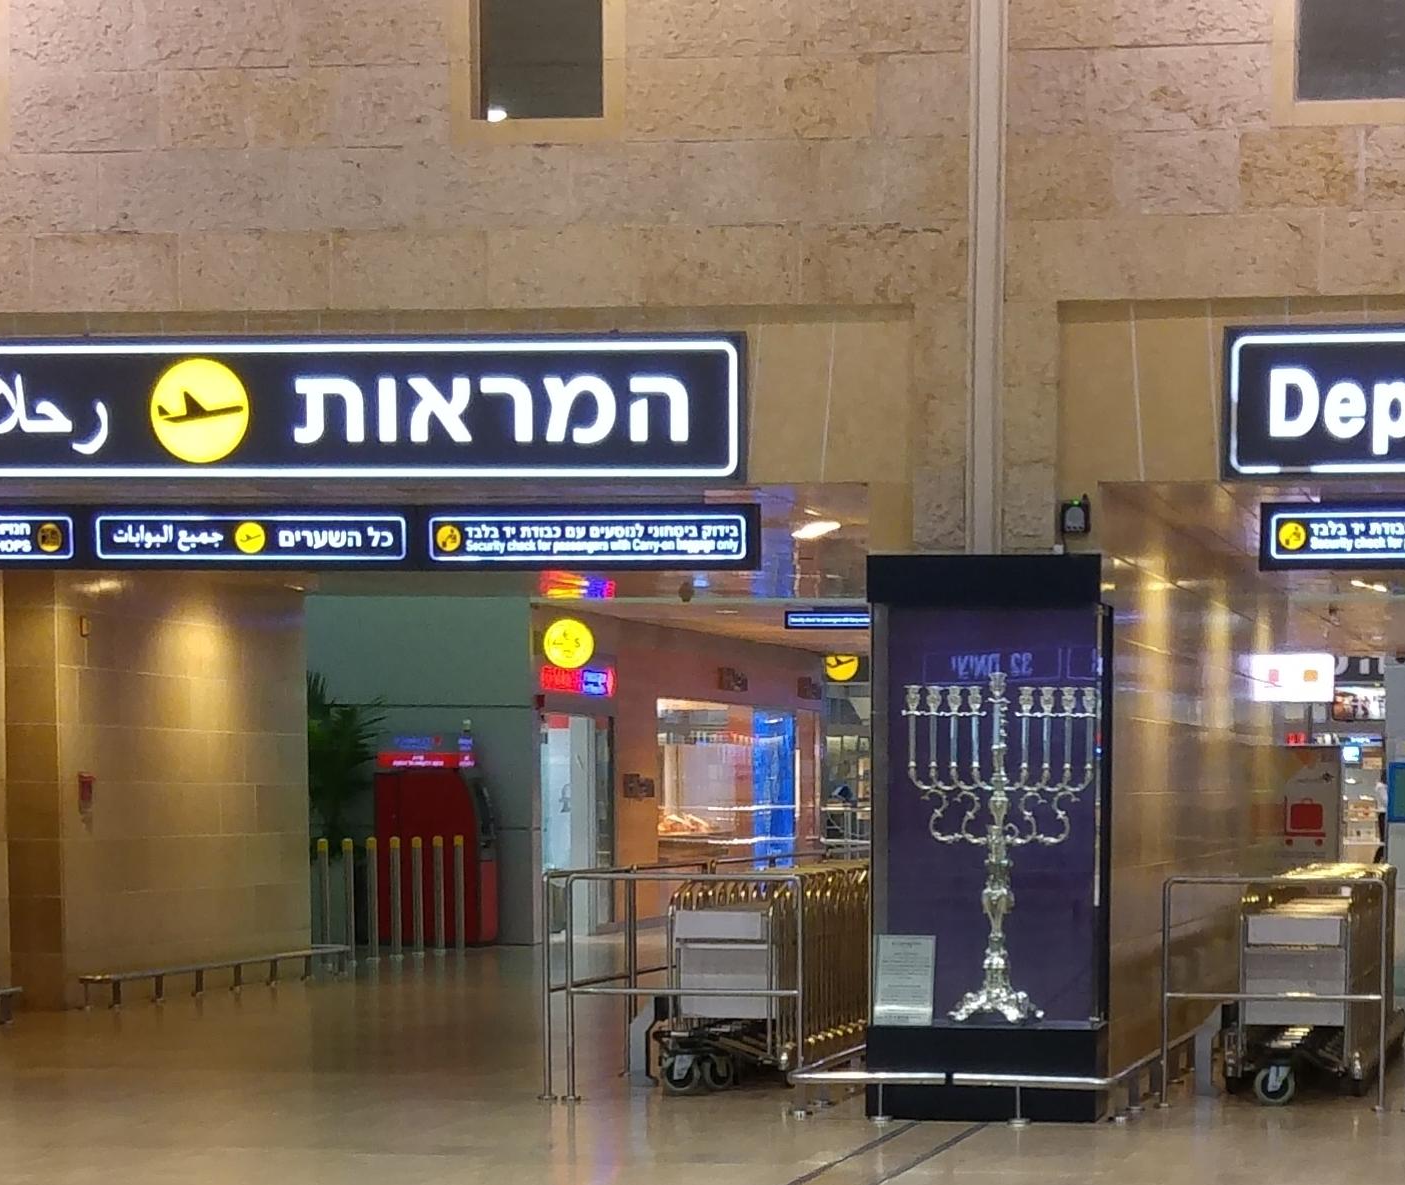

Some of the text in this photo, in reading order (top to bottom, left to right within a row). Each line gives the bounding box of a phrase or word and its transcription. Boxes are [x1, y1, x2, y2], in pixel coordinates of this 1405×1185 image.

[293, 373, 690, 446] המראות
[464, 523, 500, 539] בלבד
[501, 525, 517, 539] יד
[563, 525, 587, 539] עם
[588, 523, 645, 540] לנוסעים
[701, 524, 739, 540] בידוק
[1309, 519, 1348, 536] בלבד
[1350, 521, 1366, 536] יד
[112, 524, 224, 551] جميع البوابات
[278, 526, 394, 550] כל השערים
[1309, 536, 1353, 551] Security
[465, 540, 505, 554] Security
[507, 540, 536, 552] check
[537, 540, 552, 552] for
[717, 539, 739, 553] only
